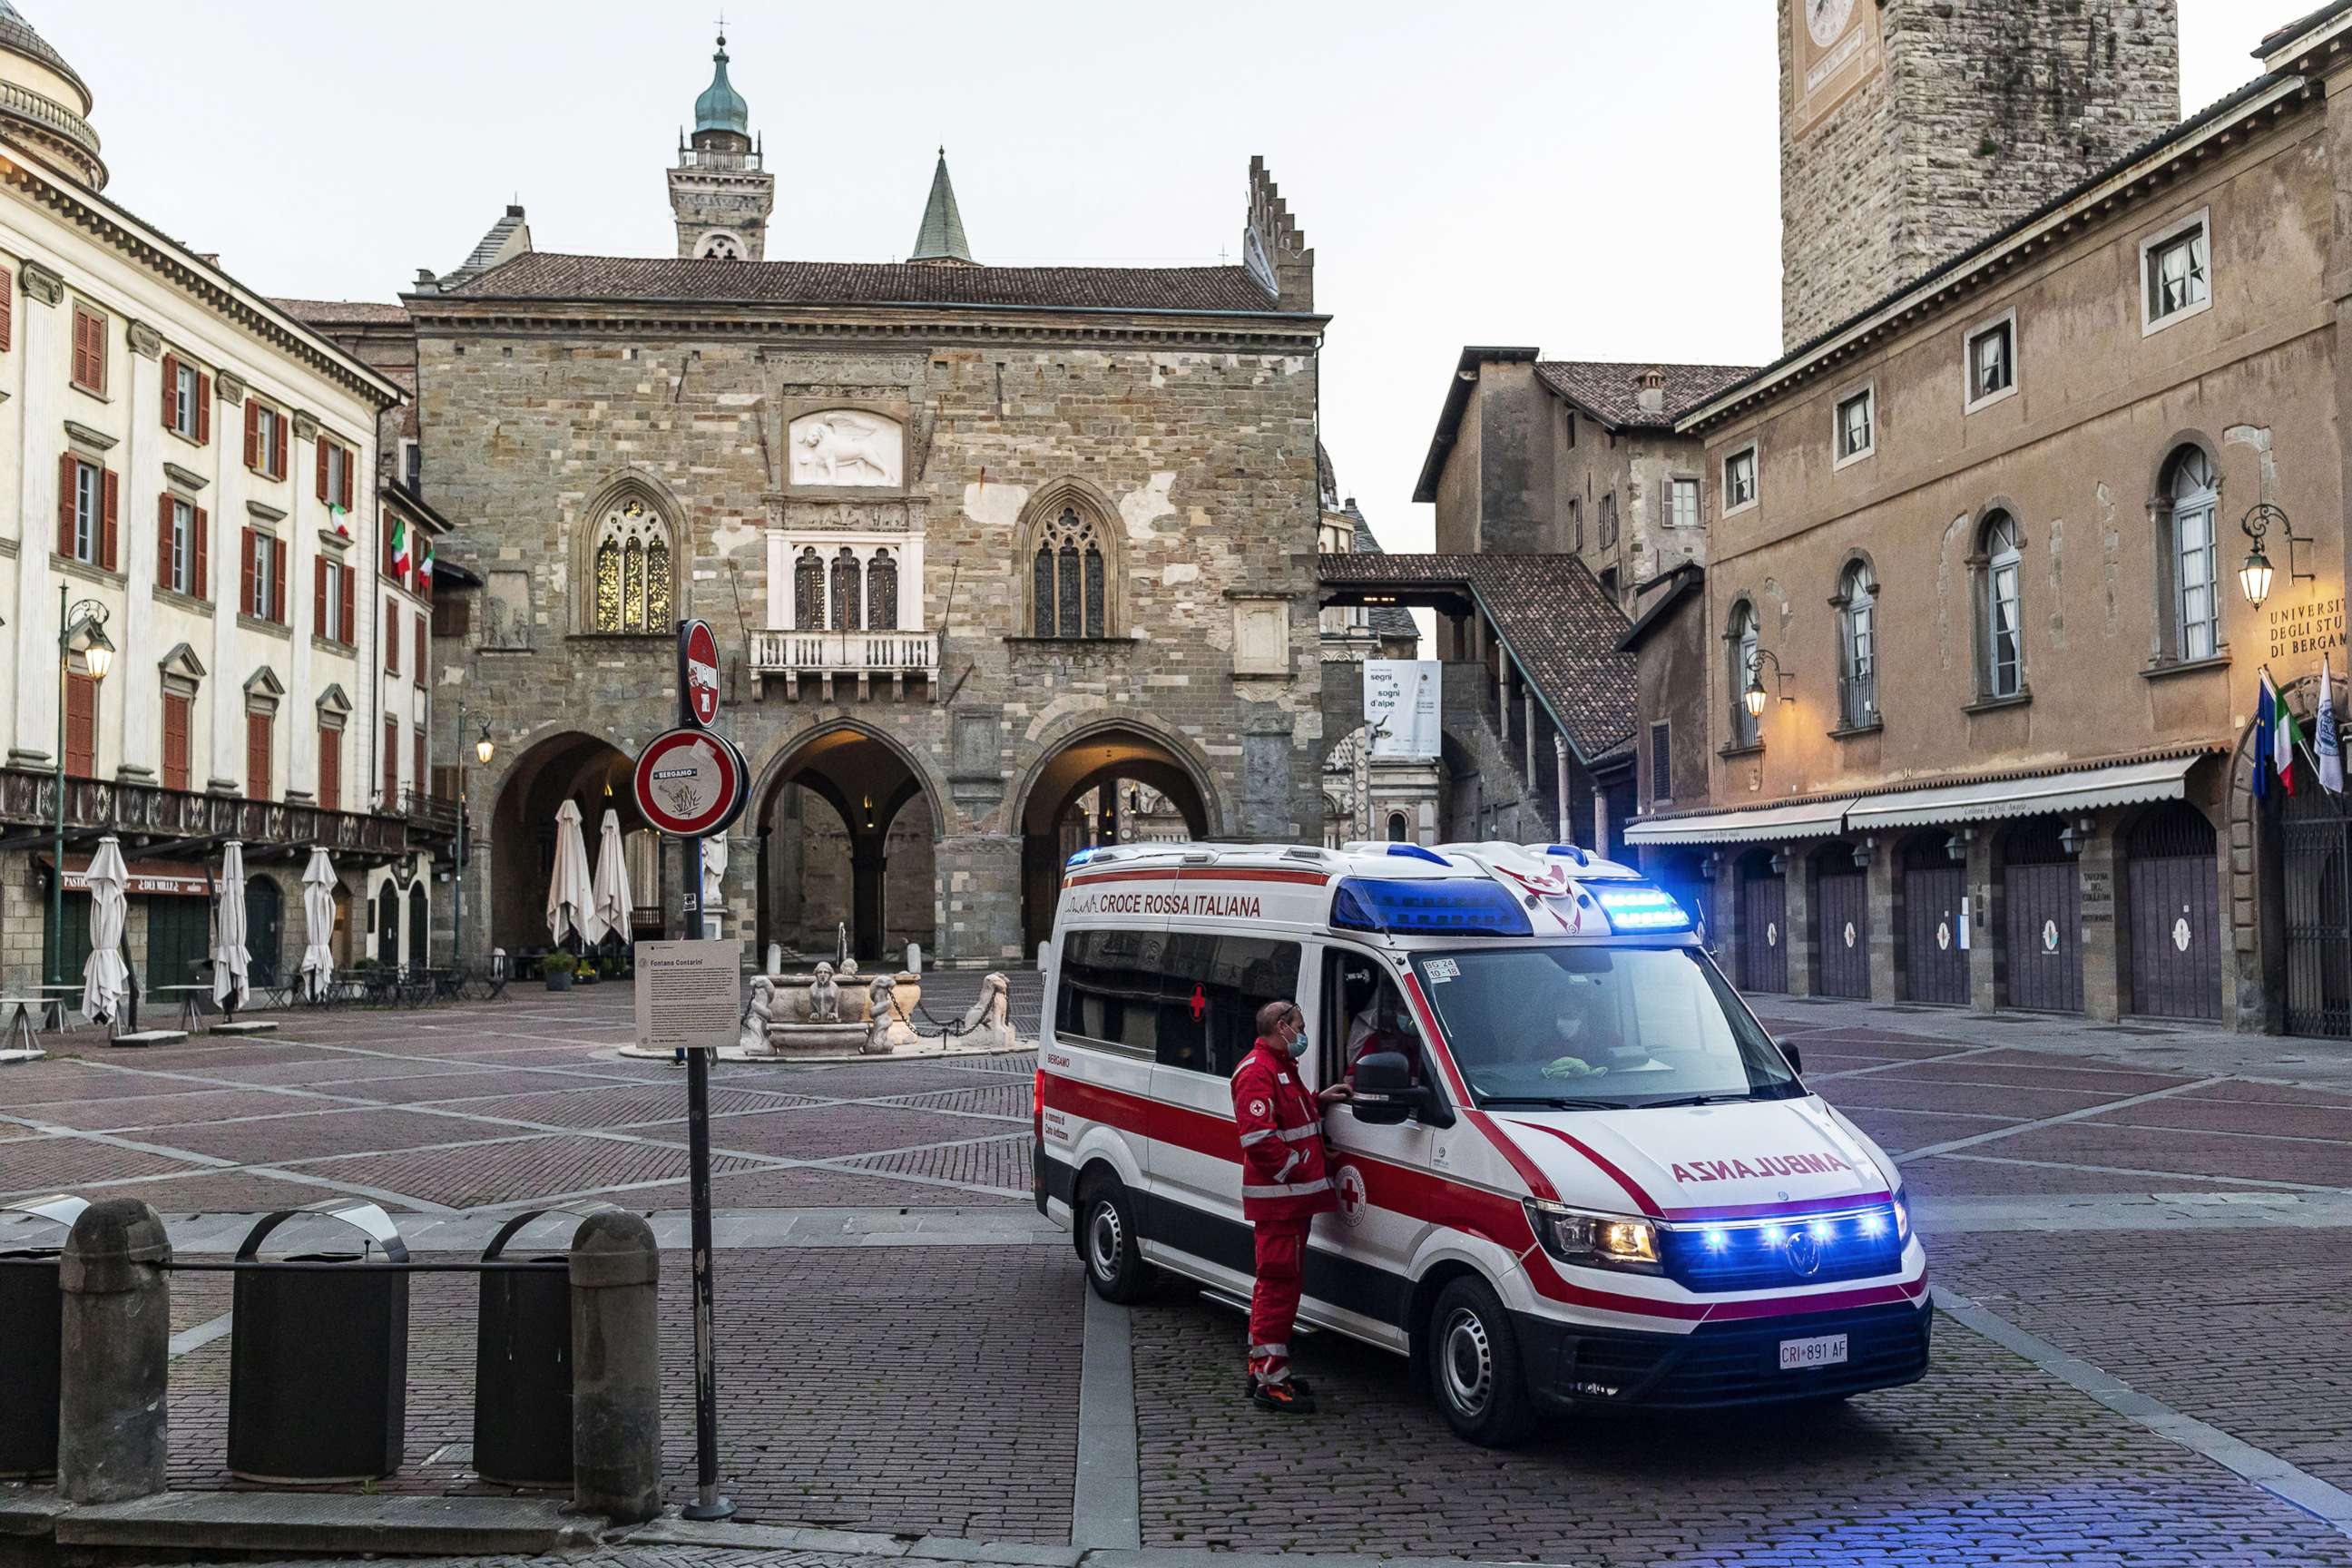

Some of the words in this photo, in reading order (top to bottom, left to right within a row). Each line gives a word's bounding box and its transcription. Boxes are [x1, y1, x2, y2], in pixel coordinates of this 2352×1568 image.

[2270, 598, 2346, 625] UNIVERSIT
[2270, 622, 2310, 642] DEGLI
[2317, 615, 2342, 633] STU
[2271, 643, 2284, 658] DI
[2292, 632, 2347, 654] BERGAM
[1378, 690, 1400, 698] sogni
[1370, 700, 1395, 708] d'alpe
[659, 769, 692, 779] BERGAMO
[64, 876, 88, 887] PASTIC
[1100, 894, 1142, 914] CROCE
[1144, 895, 1190, 915] ROSSA
[1193, 896, 1260, 917] ITALIANA
[1425, 961, 1439, 969] BG
[1047, 1053, 1070, 1068] BERGAMO
[1782, 1346, 1800, 1363] CRI
[1807, 1343, 1827, 1360] 891
[1833, 1340, 1846, 1358] AF
